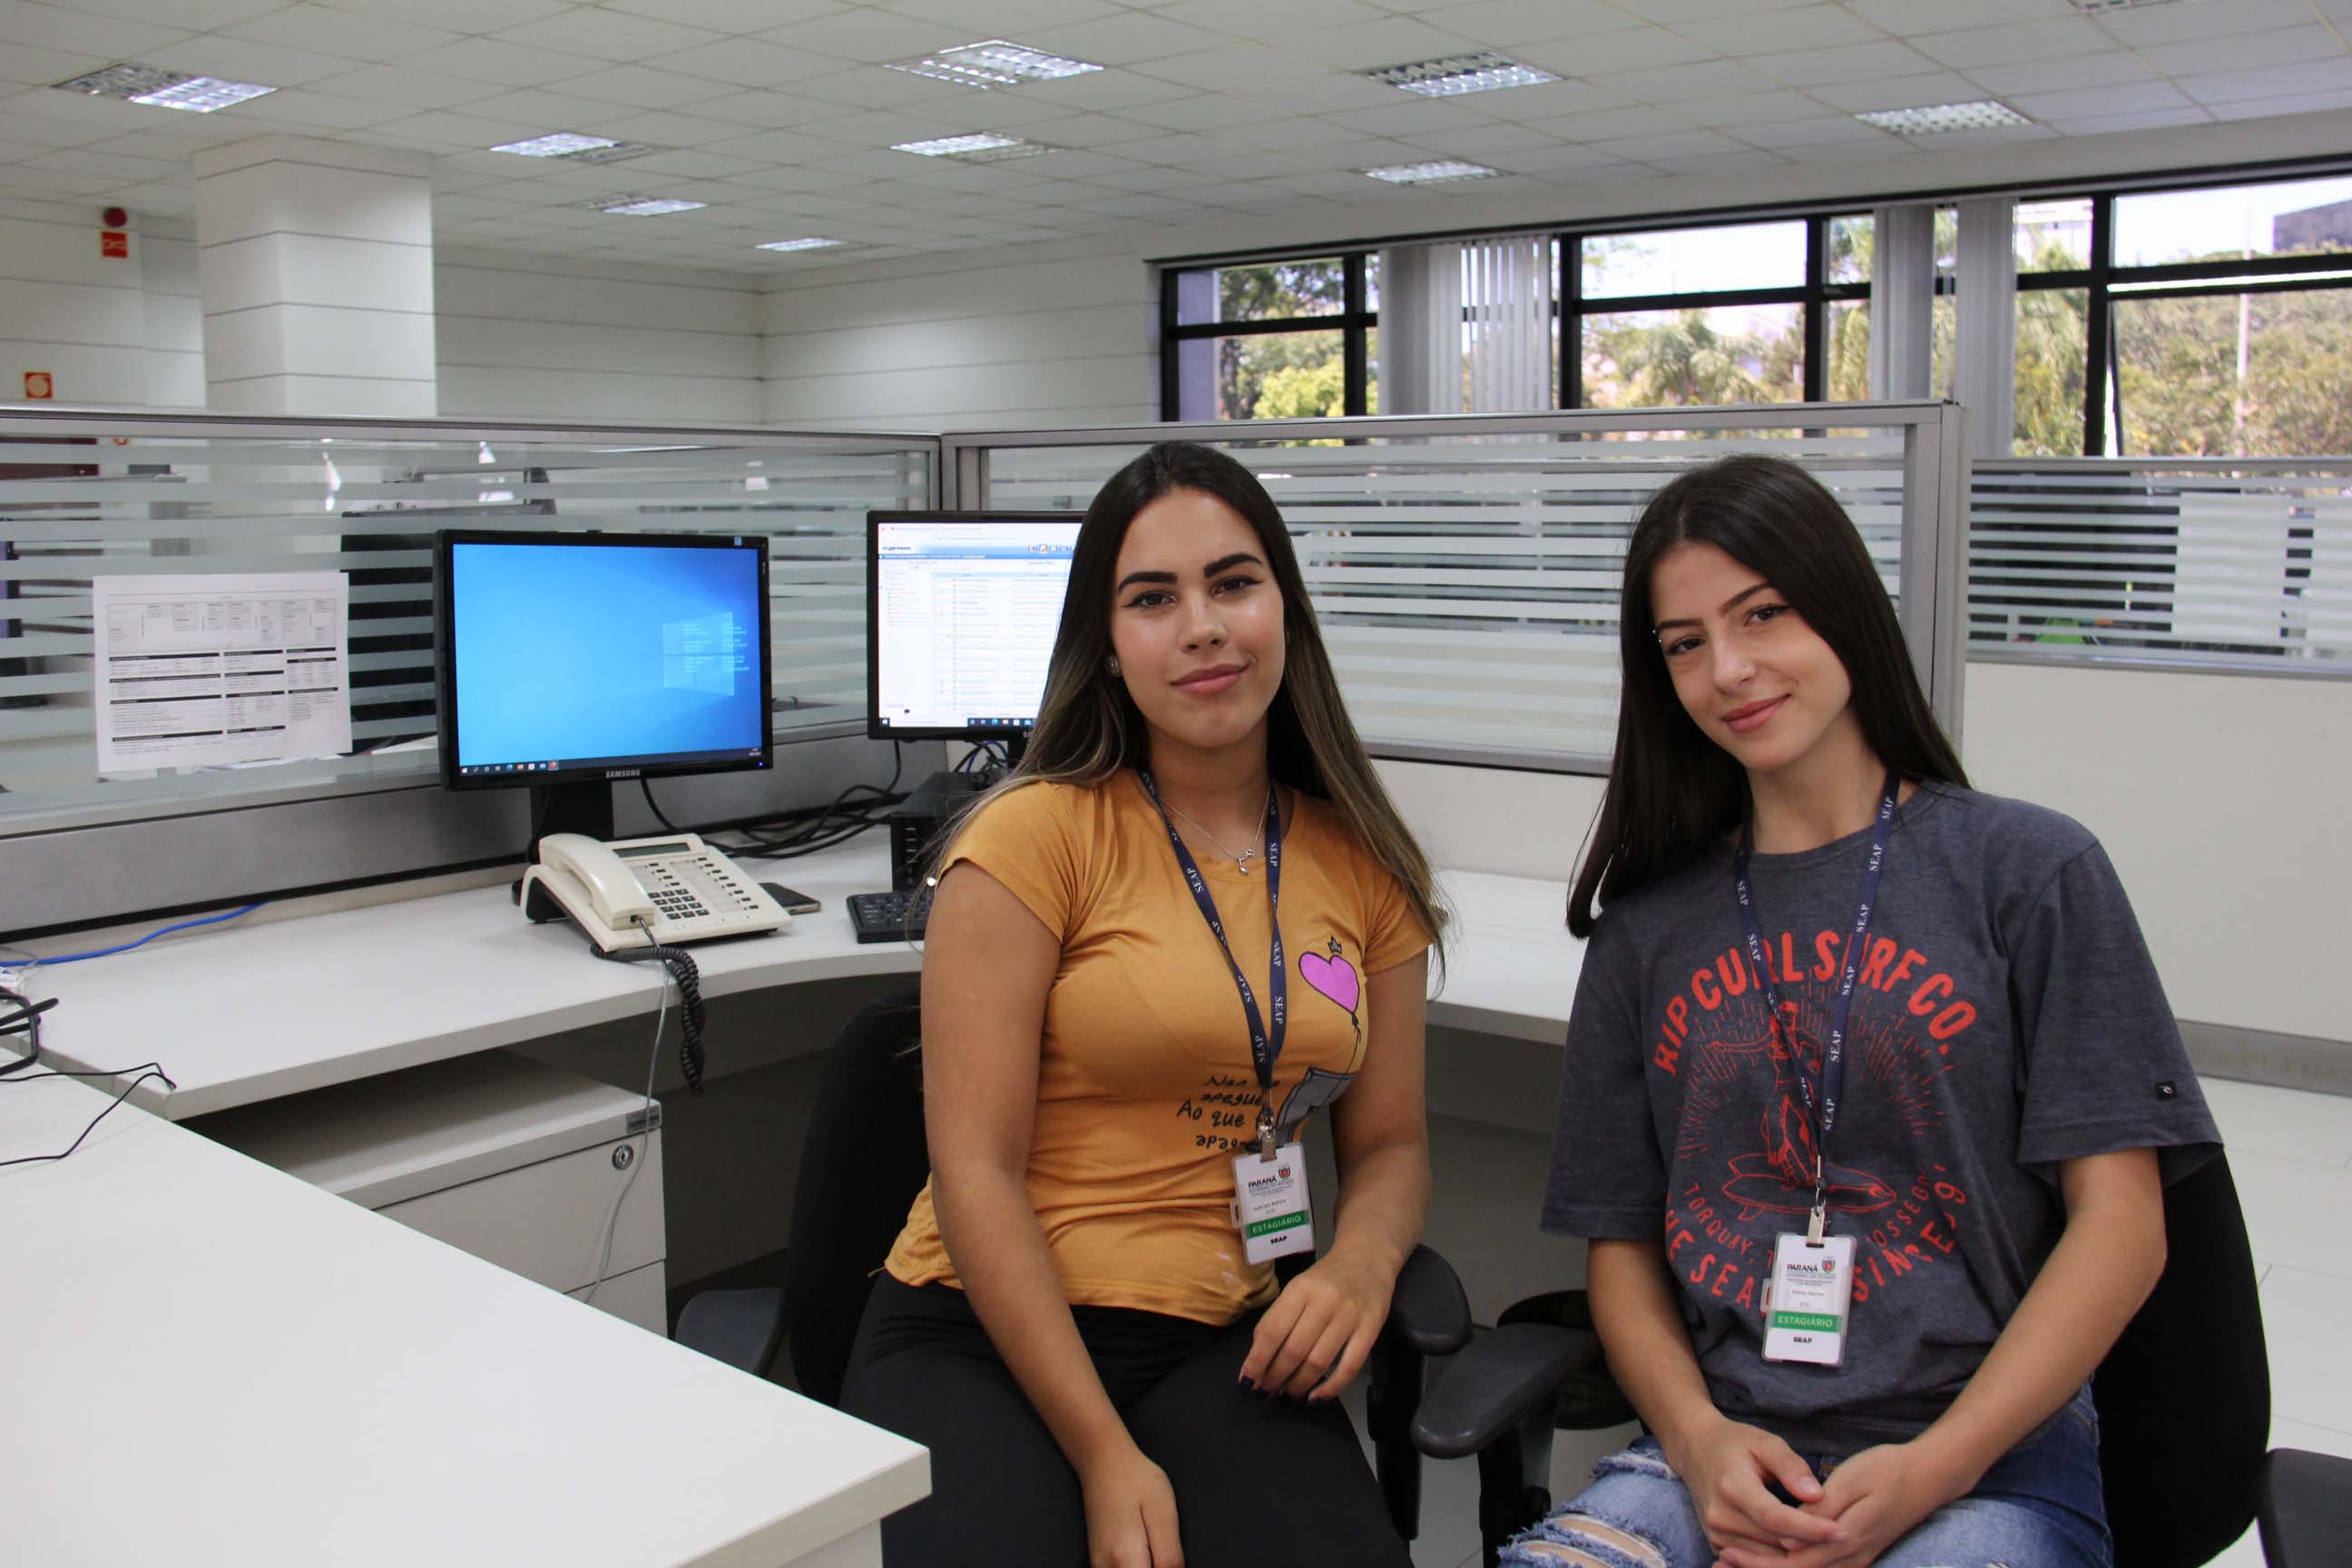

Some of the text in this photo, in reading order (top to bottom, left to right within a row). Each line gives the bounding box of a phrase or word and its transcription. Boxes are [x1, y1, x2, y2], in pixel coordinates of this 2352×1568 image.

[605, 769, 641, 779] SAMSUNG
[1869, 844, 1884, 872] SEAP
[1187, 867, 1204, 894] SEAP
[1737, 880, 1749, 906] SEAP
[1856, 904, 1869, 933] SEAP
[1273, 941, 1281, 967] SEAP
[1748, 933, 1761, 962] SEAP
[1842, 965, 1855, 995] SEAP
[1275, 995, 1284, 1024] SEAP
[1654, 995, 1689, 1075] RIP
[1907, 973, 1977, 1056] CO.
[1830, 1030, 1841, 1062] SEAP
[1177, 1099, 1203, 1120] Ao
[1211, 1110, 1245, 1128] que
[1825, 1098, 1836, 1131] SEAP
[1270, 1235, 1288, 1244] SEAP
[1778, 1315, 1833, 1328] ESTAGIÁRIO
